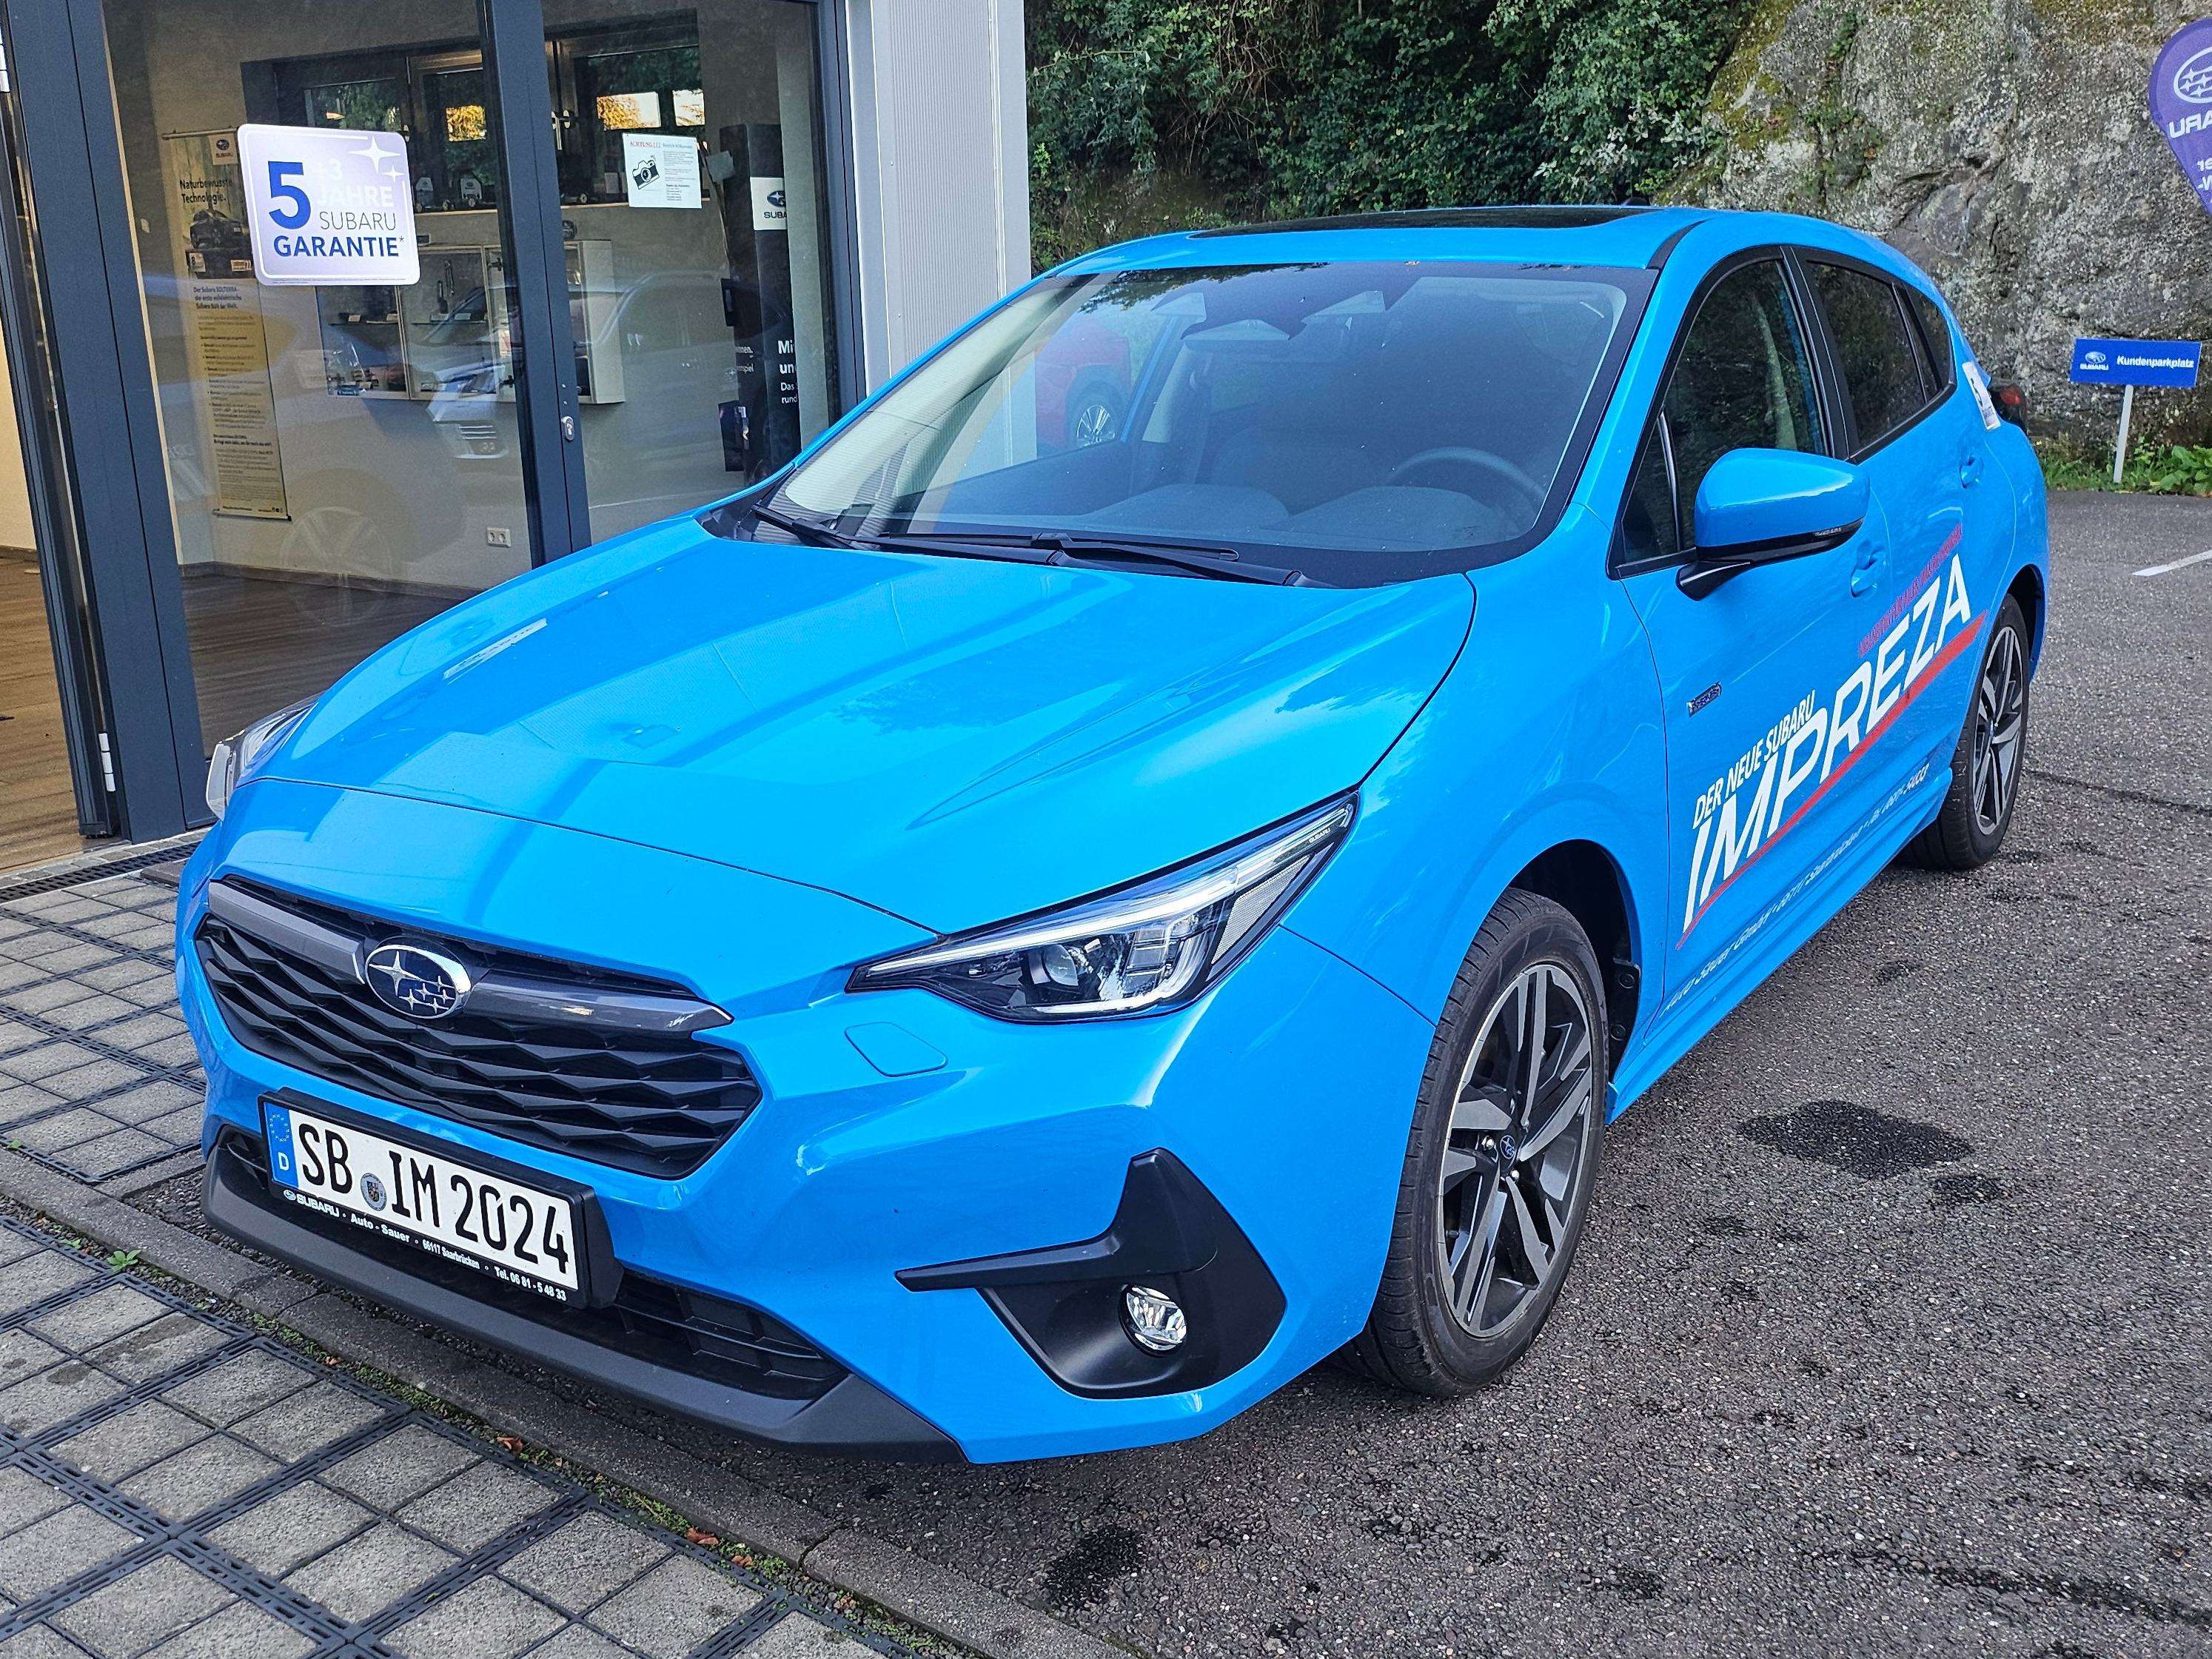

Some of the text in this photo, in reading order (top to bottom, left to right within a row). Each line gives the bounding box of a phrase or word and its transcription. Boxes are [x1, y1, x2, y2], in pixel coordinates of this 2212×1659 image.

[268, 161, 312, 229] 5
[318, 184, 395, 207] JAHRE
[319, 211, 397, 230] SUBARU
[2117, 355, 2193, 369] Kundenparkplatz
[1682, 552, 1971, 934] IMPREZA
[1692, 777, 1724, 829] DER
[1725, 738, 1764, 800] NEUE
[1763, 689, 1816, 762] SUBARU
[278, 1151, 289, 1171] D
[298, 1123, 353, 1194] SB
[389, 1150, 440, 1228] IM
[450, 1174, 569, 1274] 2024
[297, 1193, 340, 1218] SUBARU
[351, 1213, 374, 1230] Auto
[381, 1224, 410, 1242] Sauer
[422, 1239, 440, 1255] 66117
[494, 1266, 509, 1281] Tel.
